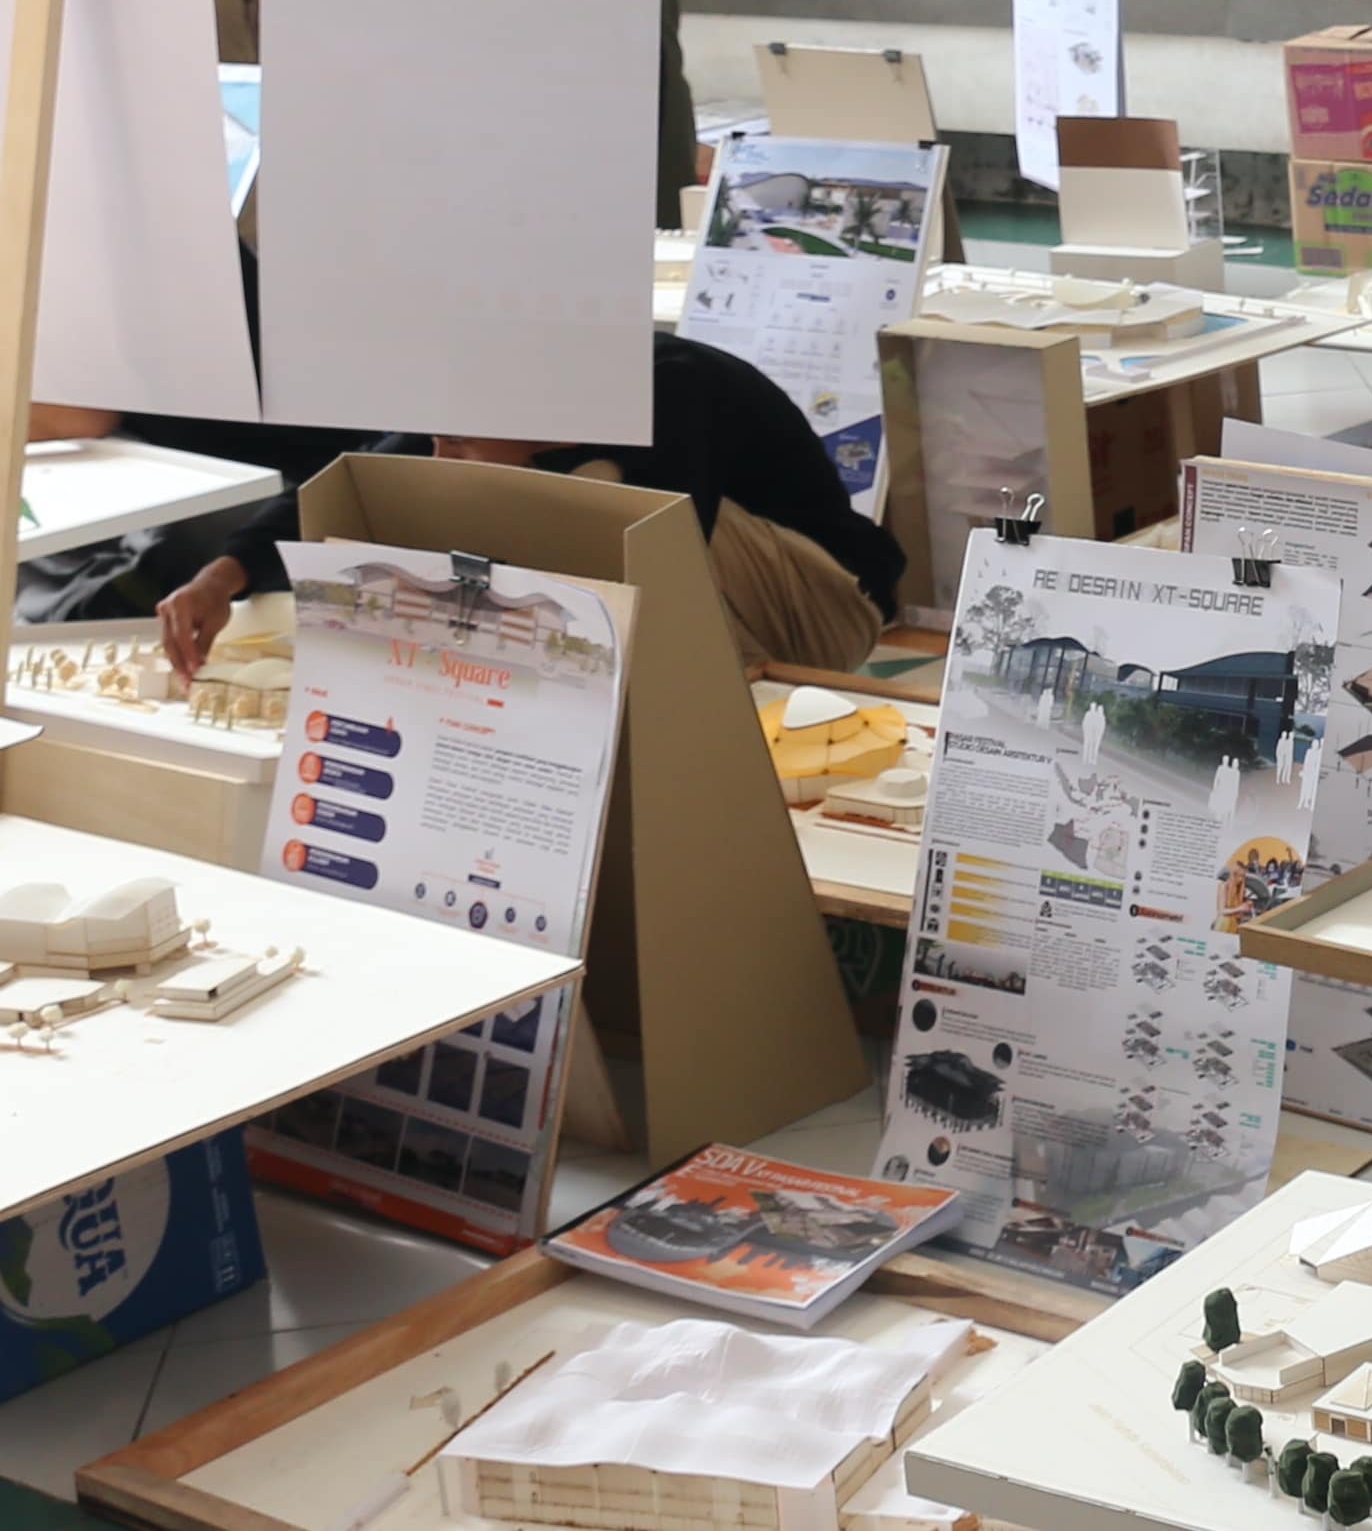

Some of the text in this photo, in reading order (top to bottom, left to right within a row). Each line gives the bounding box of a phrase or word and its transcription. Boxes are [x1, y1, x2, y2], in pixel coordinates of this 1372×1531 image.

[1033, 569, 1264, 617] RE DESAIN XT-SQUARE
[438, 652, 511, 689] Square
